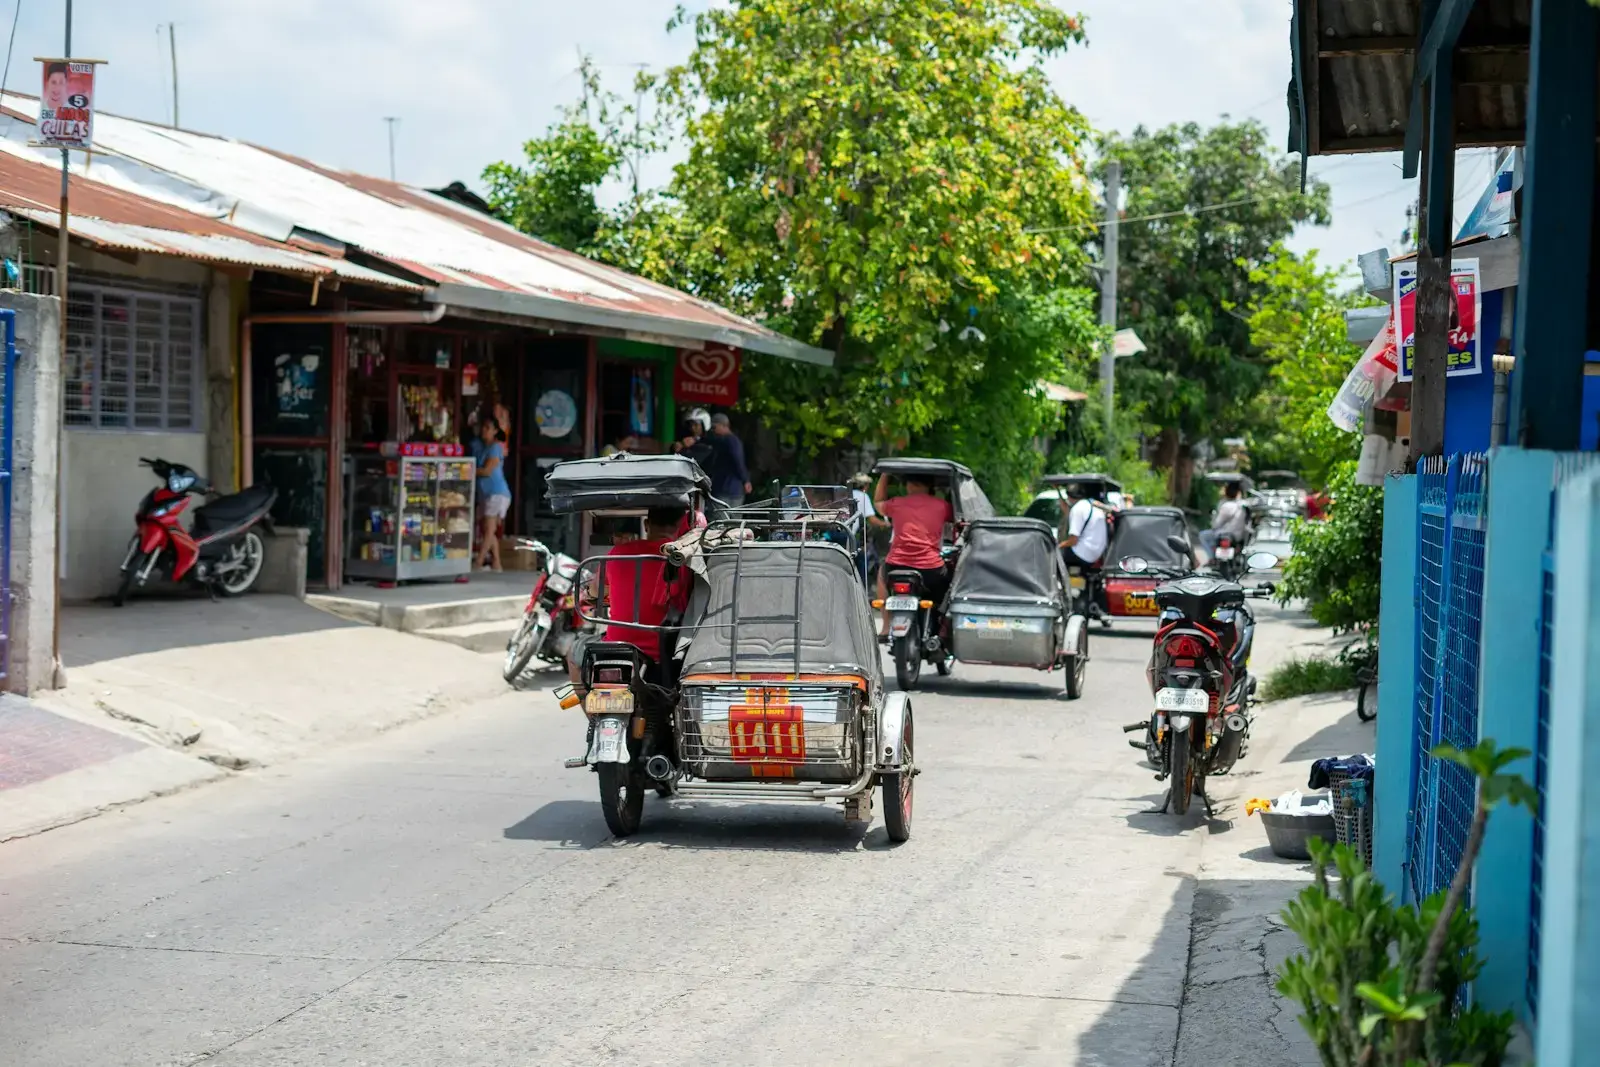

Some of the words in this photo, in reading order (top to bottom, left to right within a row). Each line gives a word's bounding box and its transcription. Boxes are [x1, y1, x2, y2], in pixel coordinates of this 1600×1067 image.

[74, 95, 83, 107] 5
[1450, 332, 1468, 345] 14
[681, 381, 729, 396] SELECTA
[735, 721, 800, 755] 1411
